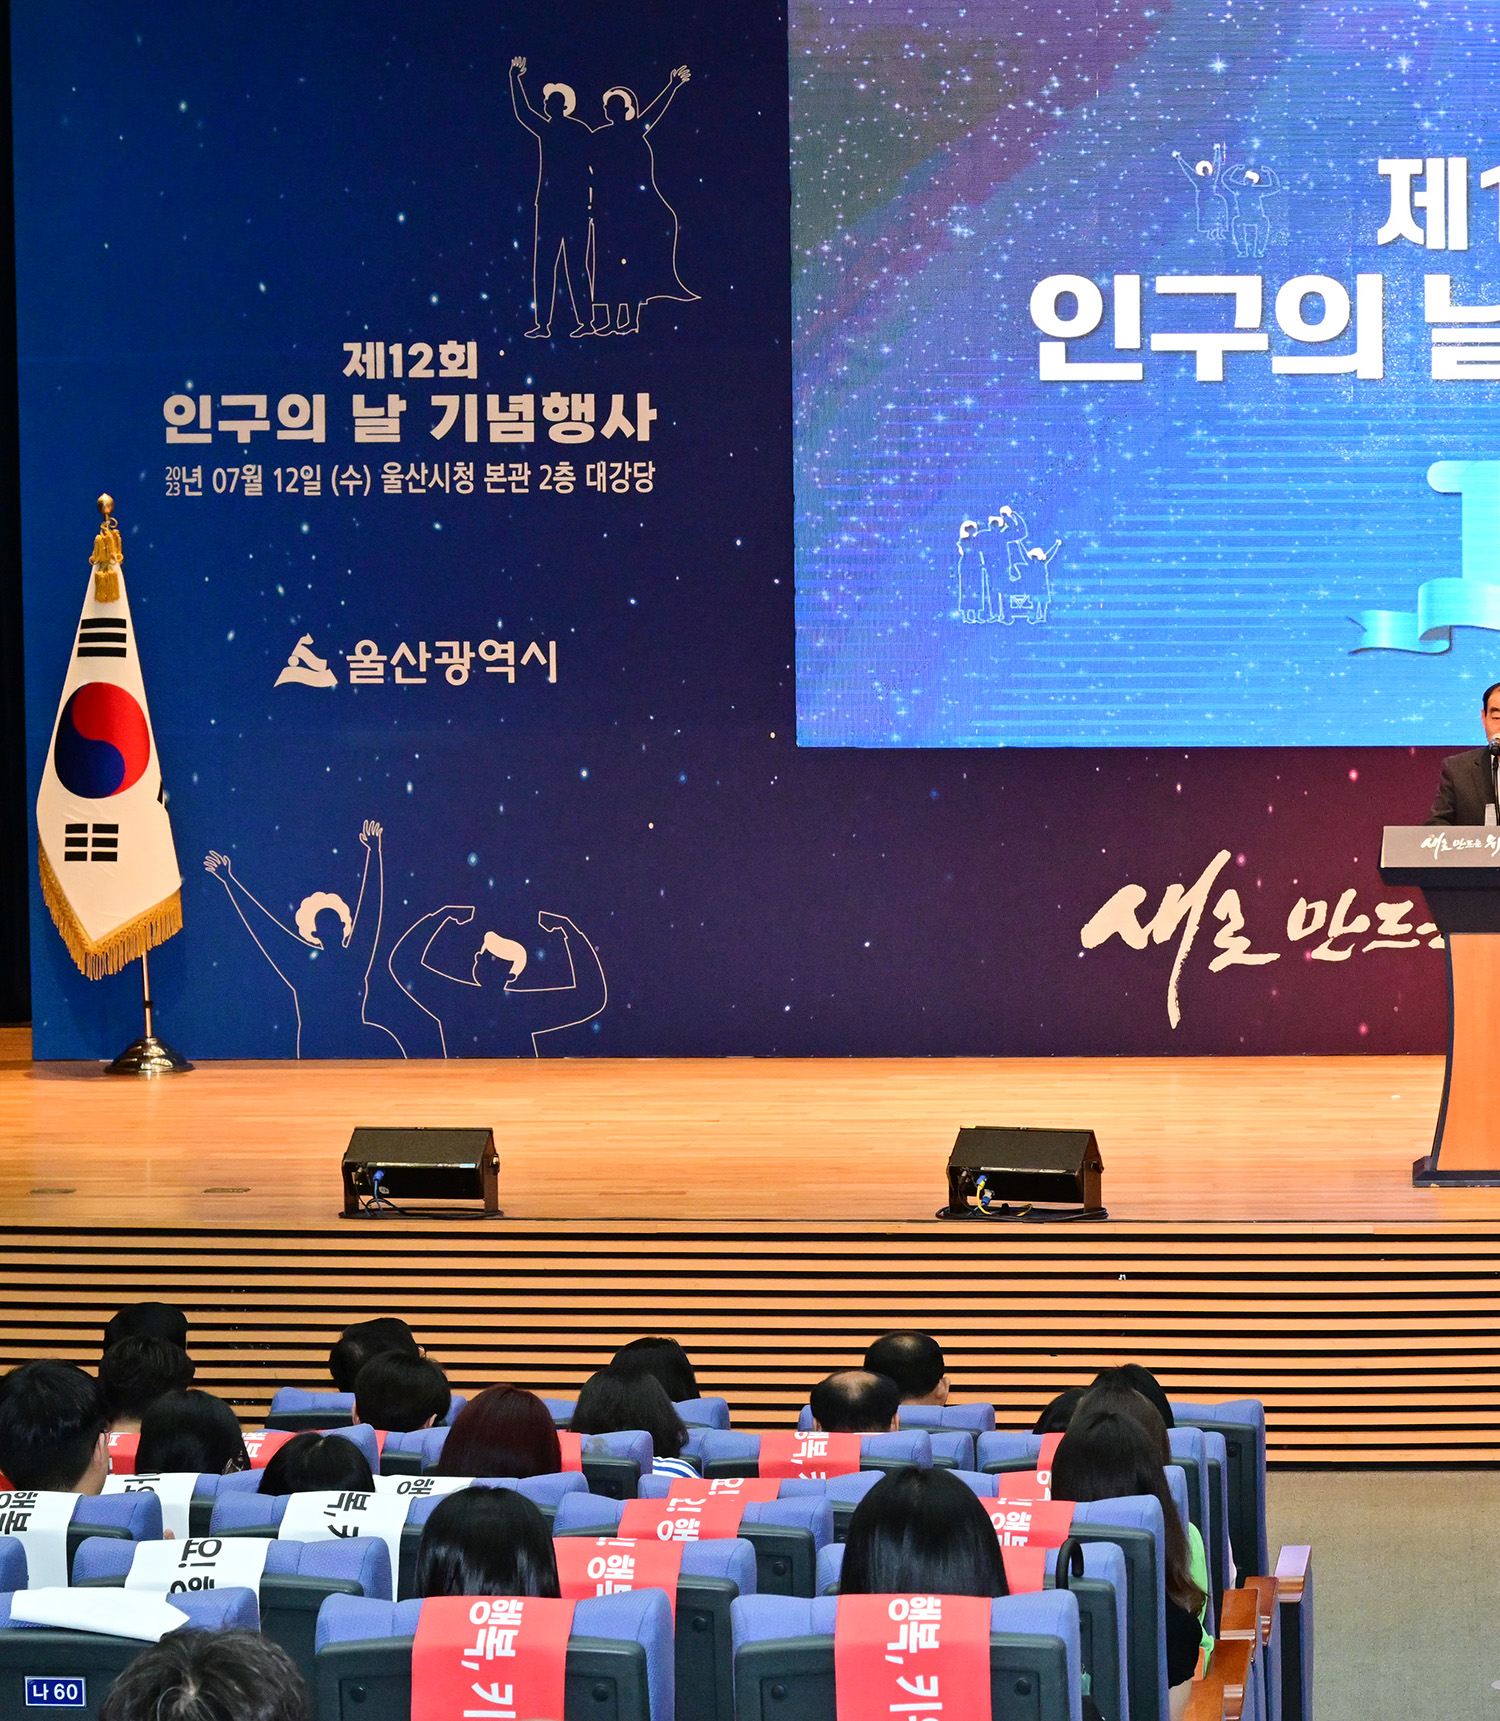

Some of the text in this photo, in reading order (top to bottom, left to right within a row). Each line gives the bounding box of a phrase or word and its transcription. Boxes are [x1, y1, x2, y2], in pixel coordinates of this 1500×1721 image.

[1029, 273, 1384, 382] 인구의
[342, 340, 478, 380] 제12회
[162, 391, 658, 444] 인구의 날 기념행사
[212, 463, 263, 496] 07월
[273, 464, 322, 496] 12일
[331, 464, 372, 497] (수)
[381, 462, 475, 495] 울산시청
[484, 462, 531, 494] 본관
[540, 462, 576, 494] 2층
[585, 461, 656, 494] 대강당
[346, 638, 557, 685] 울산광역시
[1080, 849, 1281, 1030] 새로
[33, 1683, 78, 1700] 나 60
